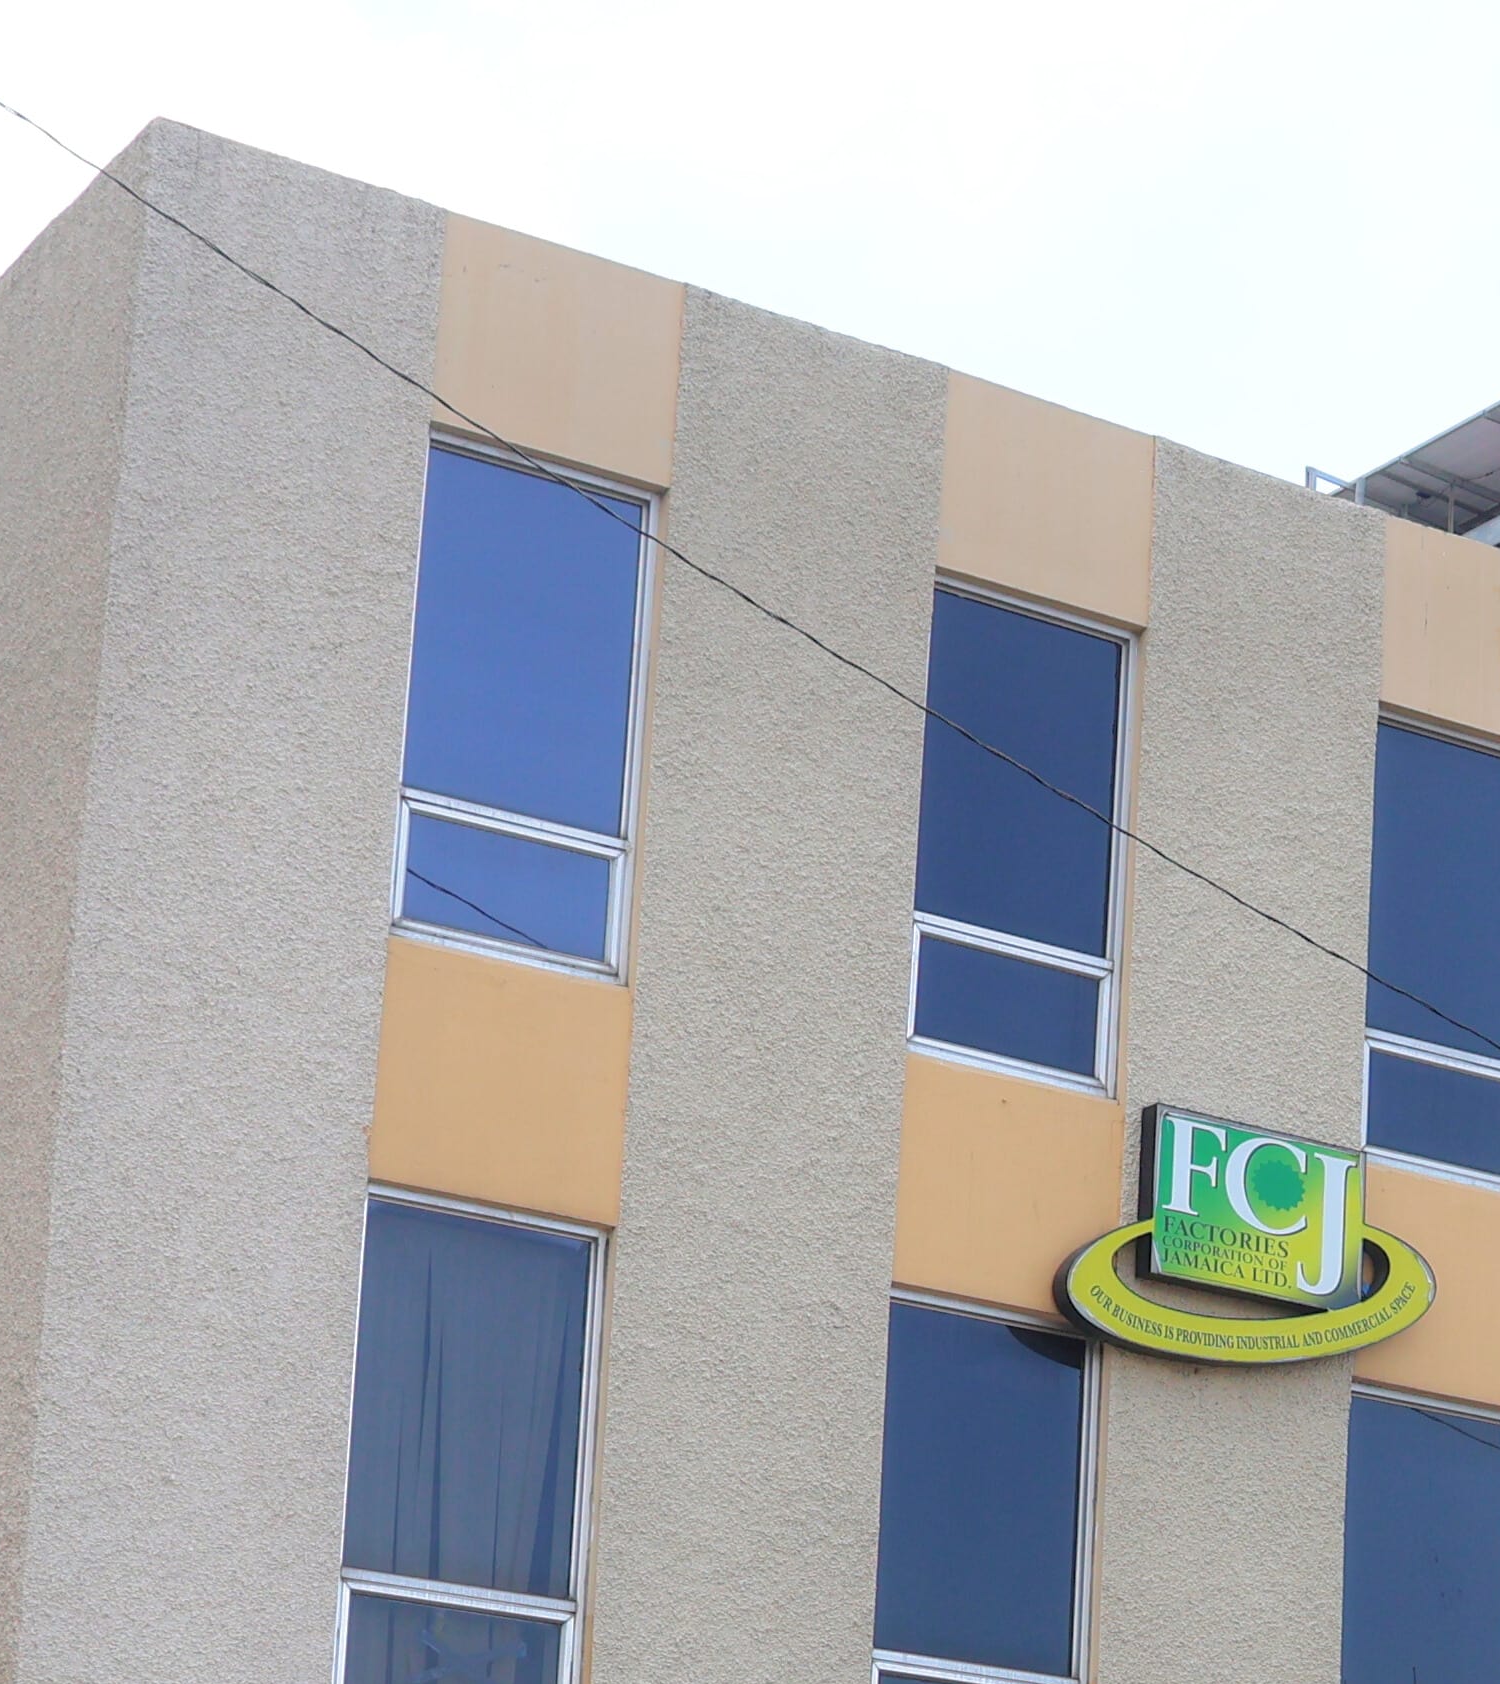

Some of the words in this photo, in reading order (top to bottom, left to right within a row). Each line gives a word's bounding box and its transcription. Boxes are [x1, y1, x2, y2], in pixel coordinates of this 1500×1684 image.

[1162, 1115, 1357, 1296] FCJ
[1162, 1235, 1262, 1266] CORPORATION
[1269, 1257, 1288, 1272] OF
[1163, 1215, 1289, 1258] FACTORIES
[1162, 1248, 1245, 1280] JAMAICA
[1252, 1270, 1293, 1289] LTD.
[1090, 1285, 1113, 1311] OUR
[1112, 1304, 1163, 1337] BUSINESS
[1164, 1325, 1174, 1340] IS
[1176, 1328, 1234, 1349] PROVIDING
[1236, 1334, 1300, 1351] INDUSTRIAL
[1302, 1331, 1323, 1347] AND
[1324, 1310, 1393, 1344] COMMERCIAL
[1390, 1281, 1416, 1315] SPACE
